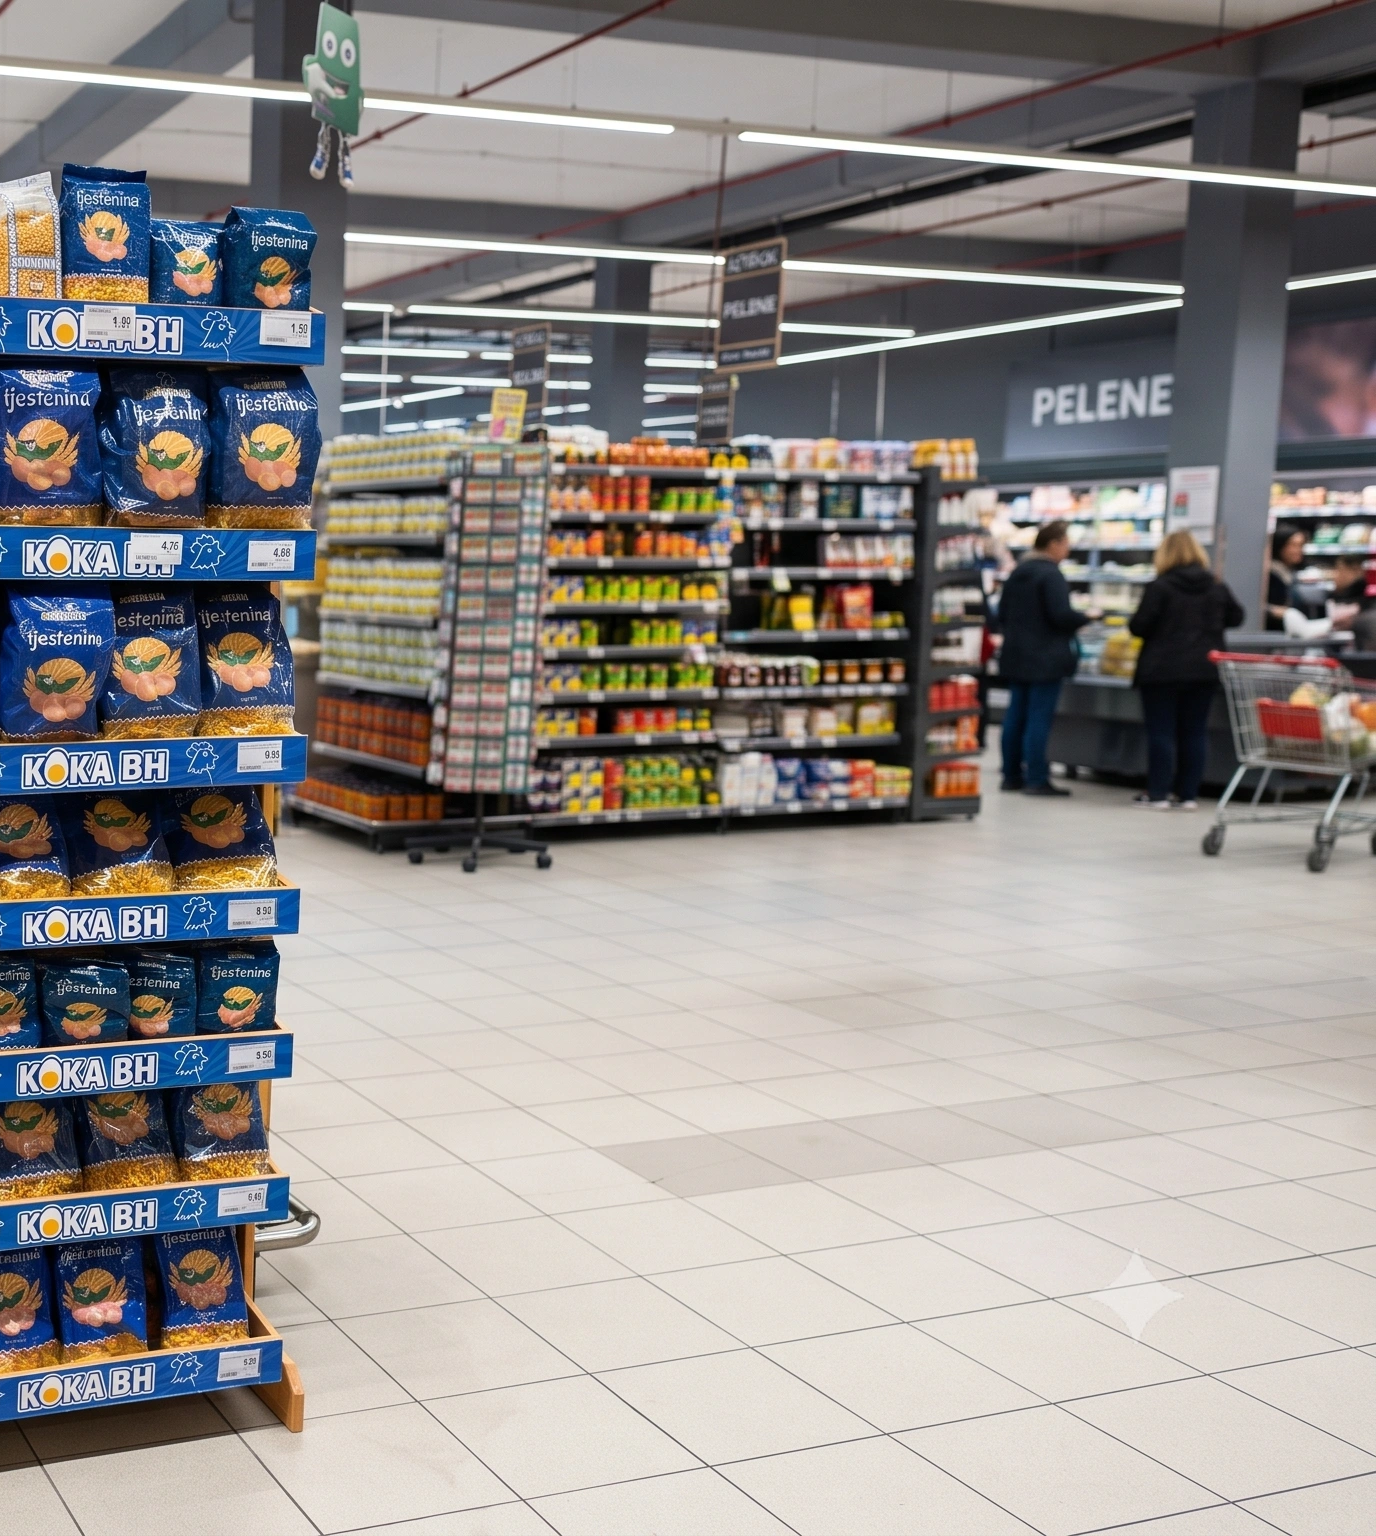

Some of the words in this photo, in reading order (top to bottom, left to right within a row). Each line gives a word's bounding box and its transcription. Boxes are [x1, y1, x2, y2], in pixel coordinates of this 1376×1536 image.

[1032, 374, 1174, 427] PELENE
[22, 535, 118, 577] KOKA
[161, 539, 179, 551] 4.76
[22, 747, 114, 788] KOKA
[118, 748, 168, 784] BH
[22, 905, 114, 946] KOKA
[118, 904, 167, 939] BH
[16, 1055, 107, 1096] KOKA
[111, 1053, 158, 1087] BH
[17, 1206, 106, 1244] KOKA
[111, 1199, 157, 1233] BH
[17, 1375, 106, 1412] KOKA
[110, 1364, 154, 1398] BH
